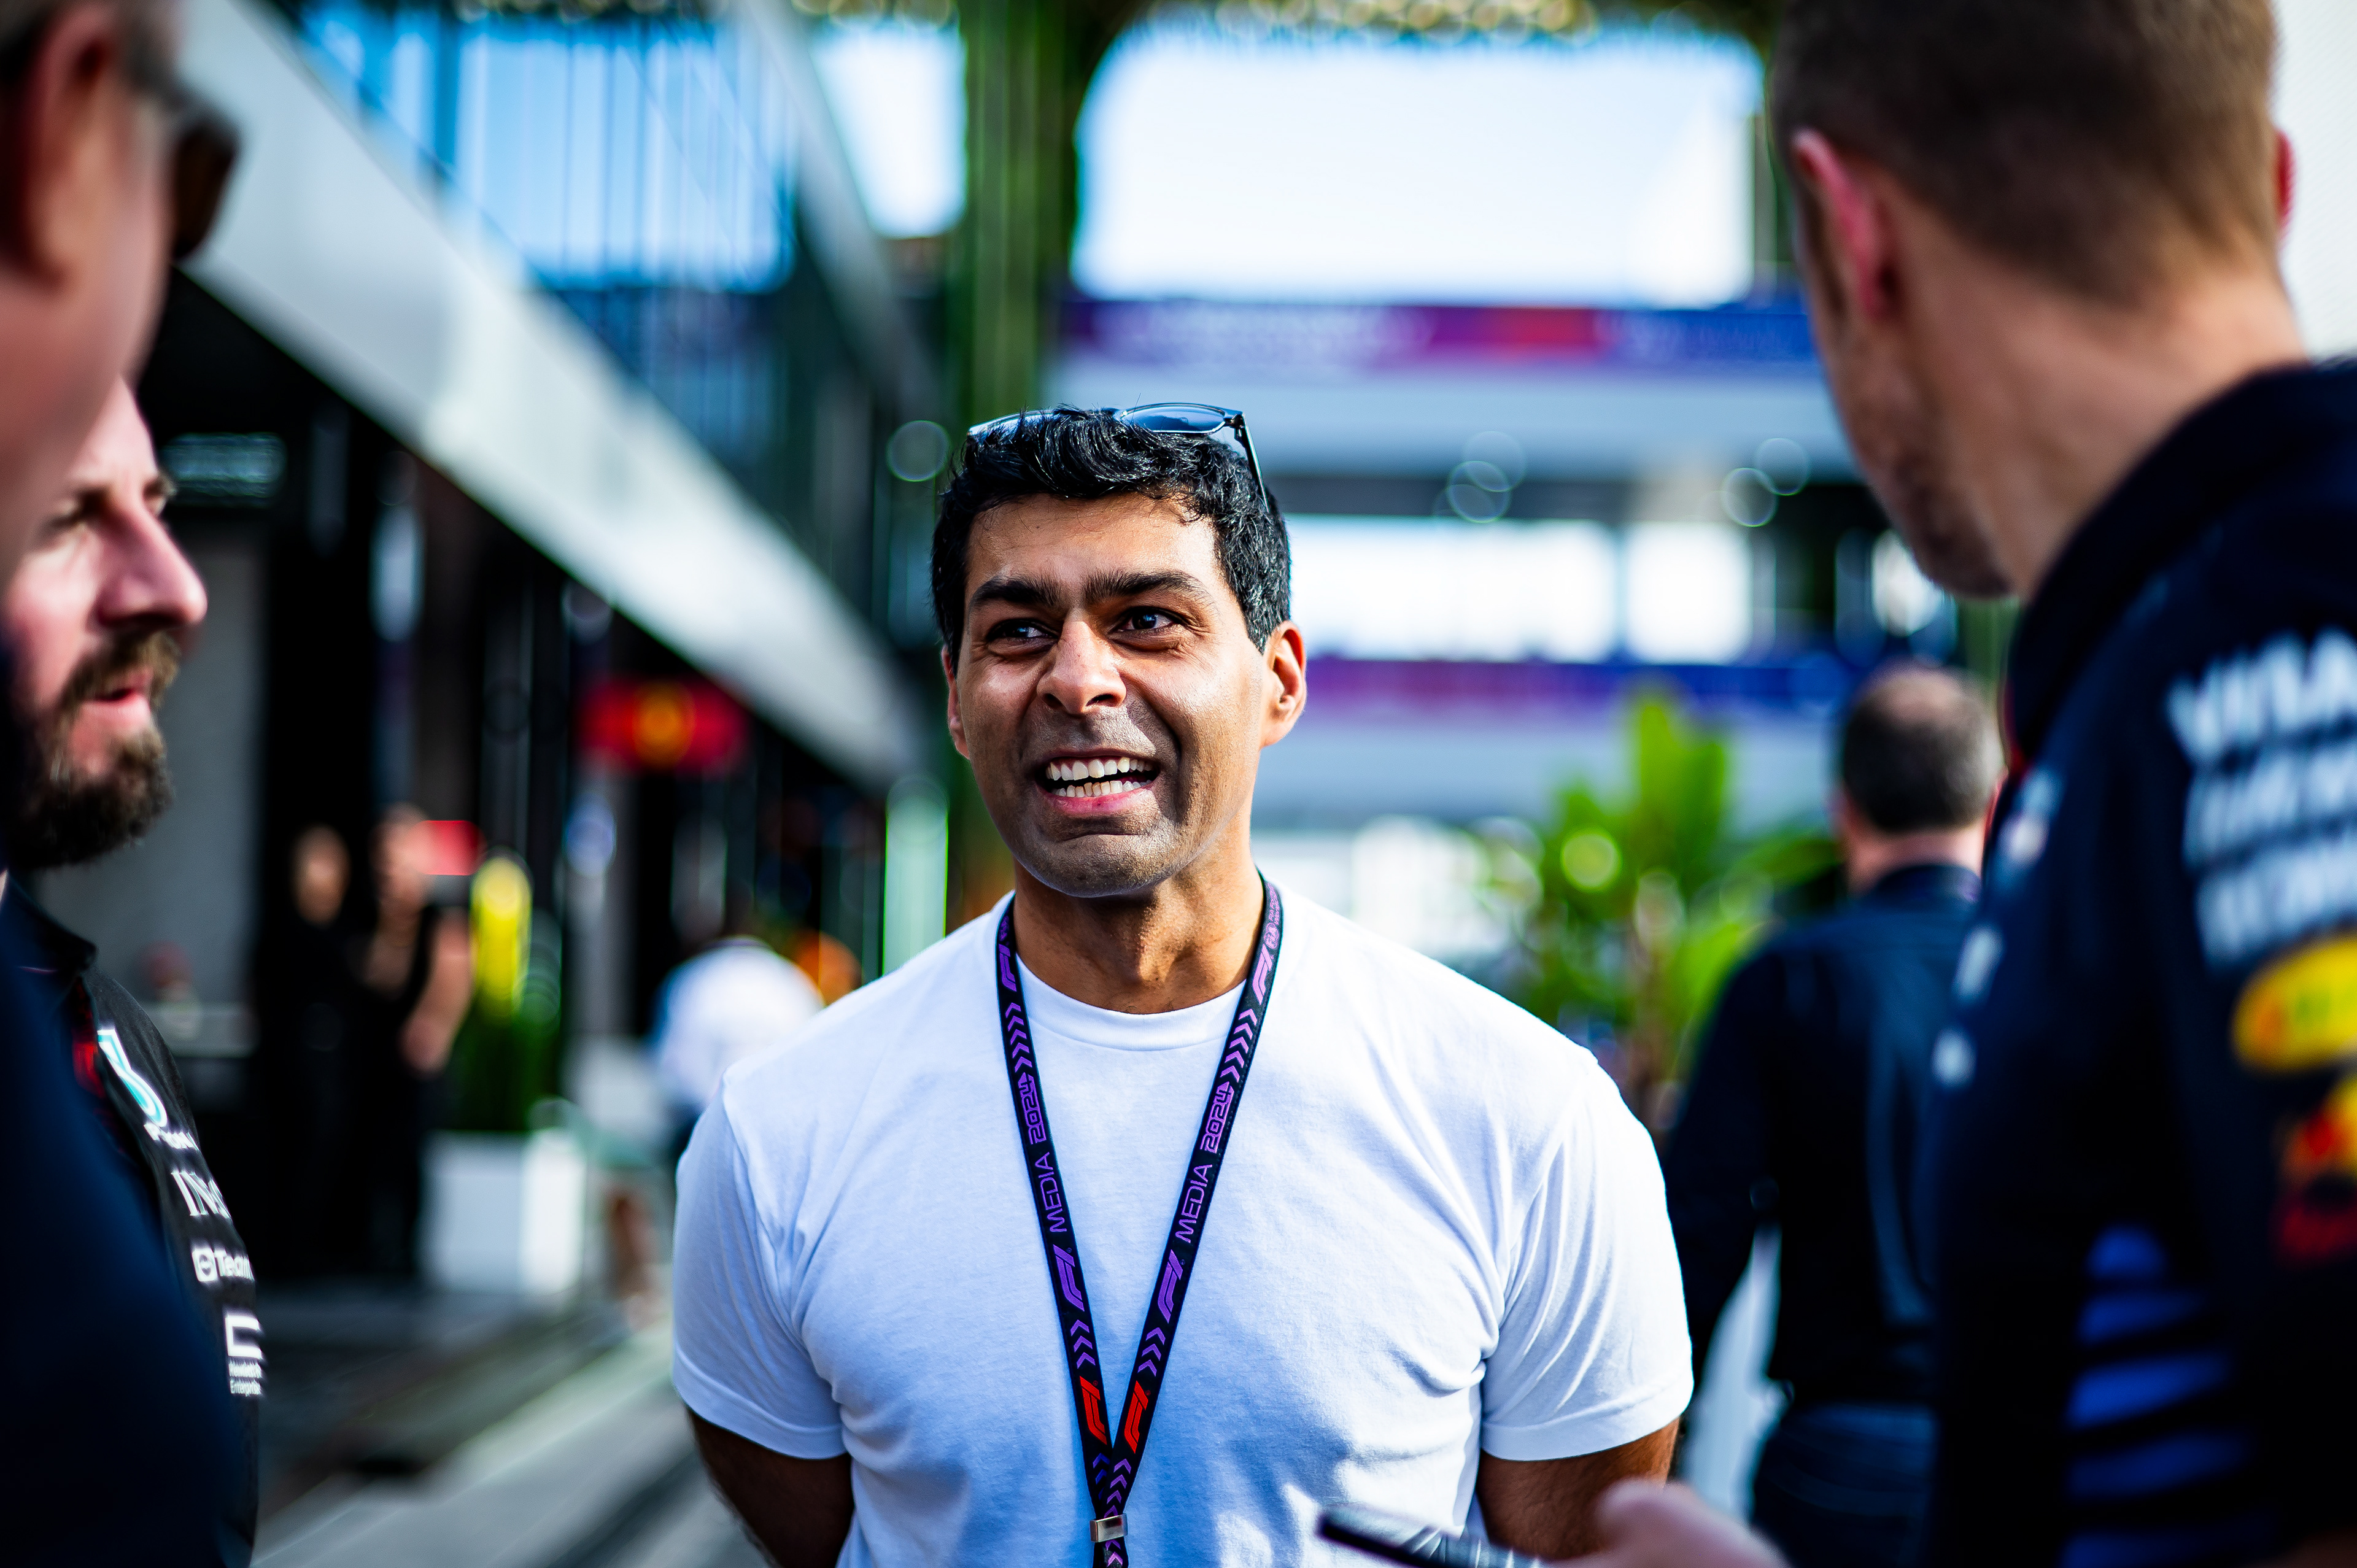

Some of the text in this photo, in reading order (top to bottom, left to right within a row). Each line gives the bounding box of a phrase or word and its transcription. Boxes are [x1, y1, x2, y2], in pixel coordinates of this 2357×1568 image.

[999, 943, 1017, 992] F1
[1252, 943, 1273, 1005] F1
[1018, 1072, 1067, 1232] MEDIA 2024
[1175, 1081, 1235, 1243] MEDIA 2024
[1053, 1244, 1085, 1312] F1
[1157, 1249, 1183, 1324] F1
[1079, 1376, 1107, 1445] F1
[1124, 1380, 1149, 1454] F1
